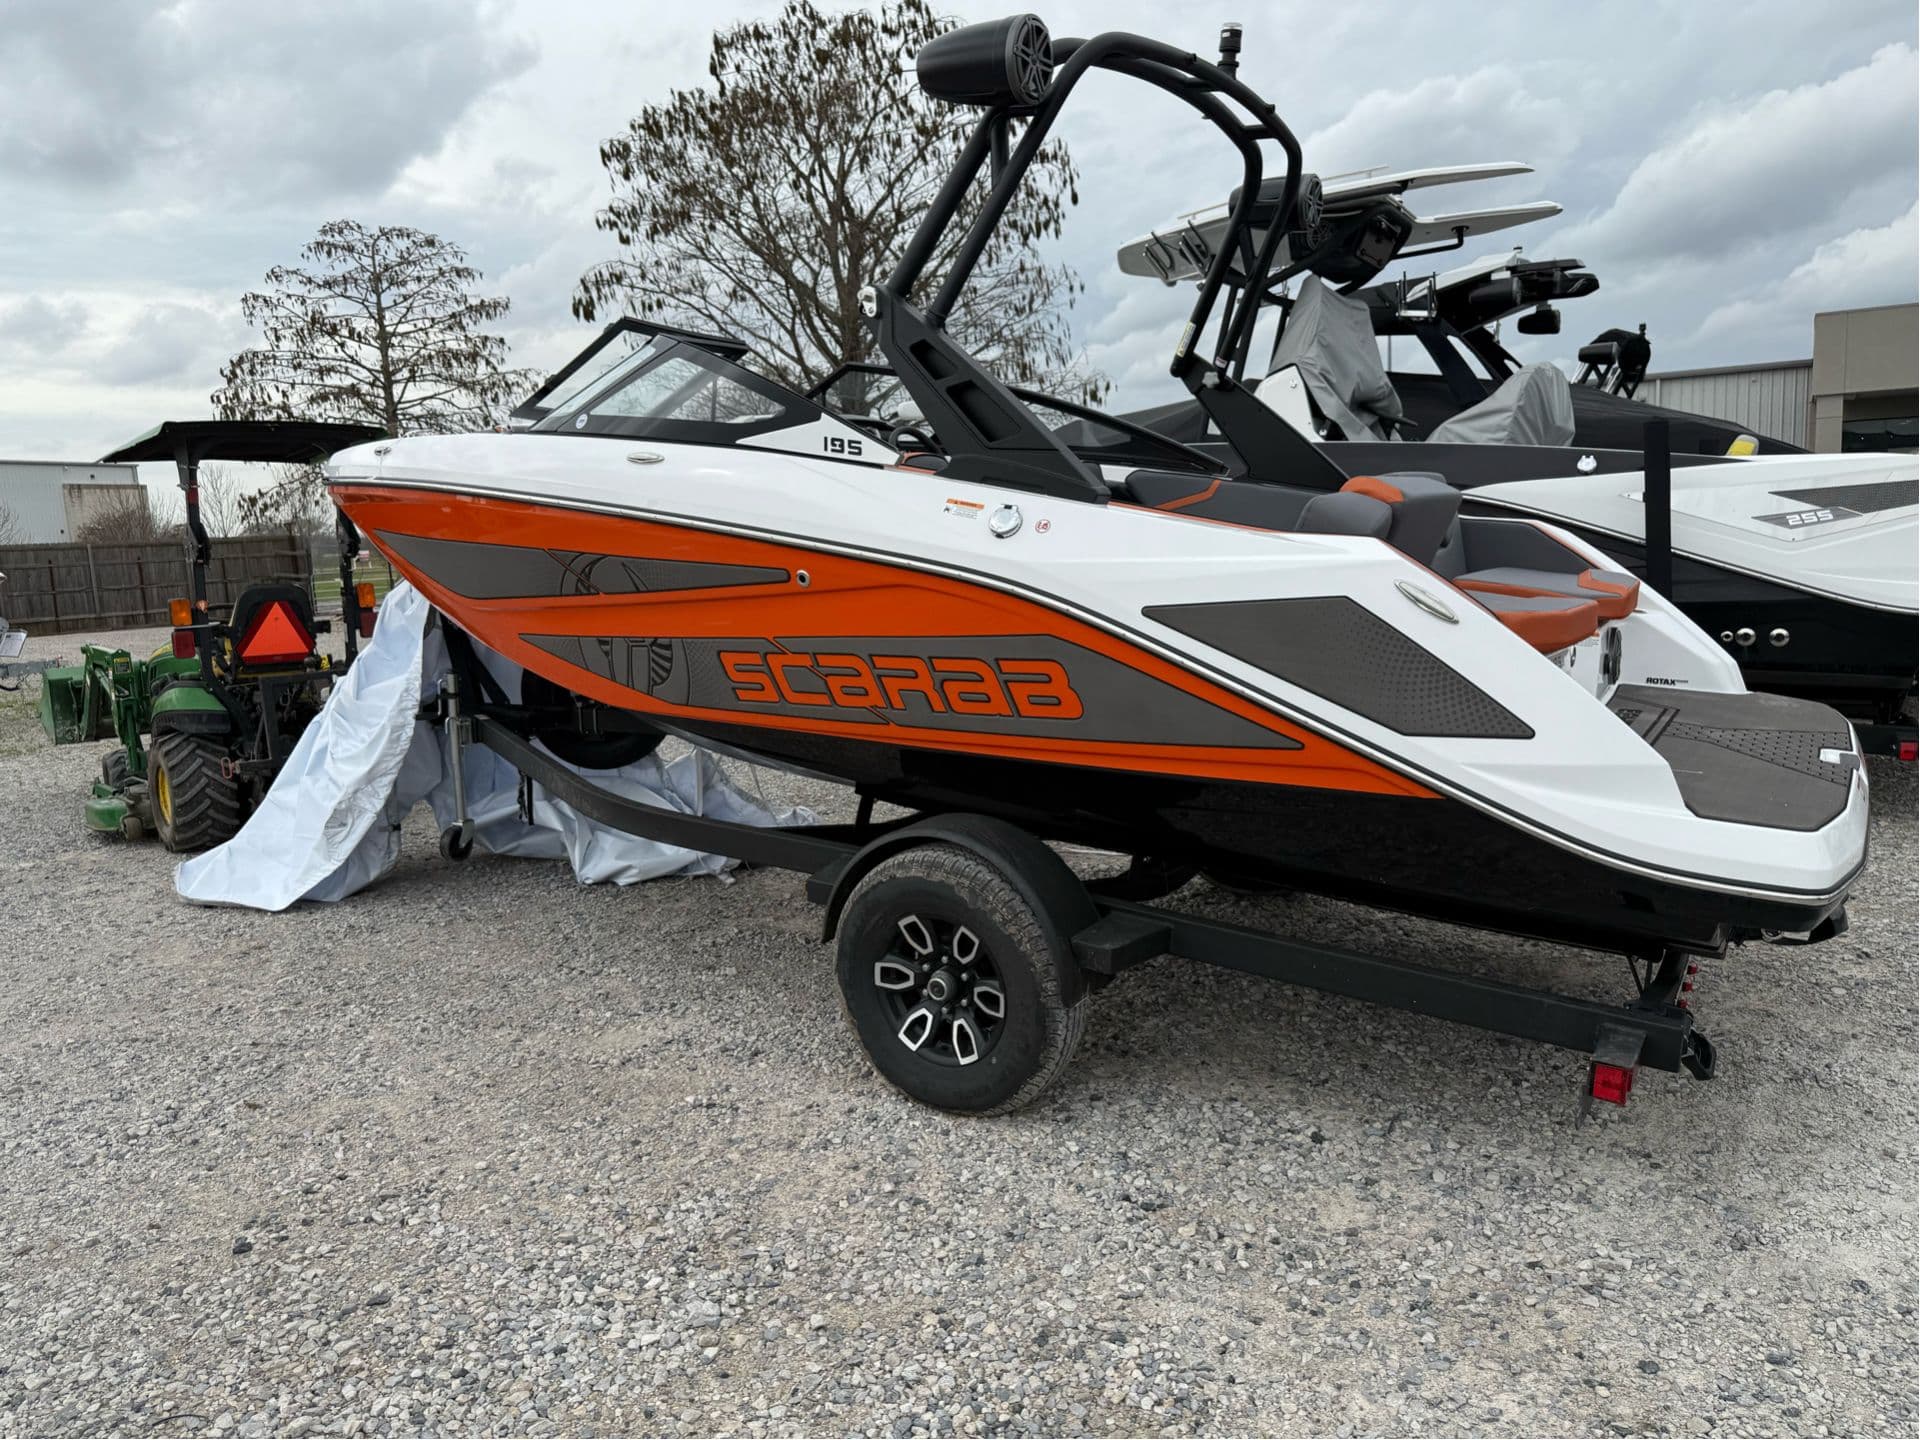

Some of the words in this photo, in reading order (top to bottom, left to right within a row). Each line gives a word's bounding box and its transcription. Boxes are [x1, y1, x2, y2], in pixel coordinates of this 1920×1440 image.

[824, 436, 862, 456] 195
[1786, 510, 1834, 526] 255
[719, 650, 1084, 720] SCARAB
[1646, 677, 1676, 685] ROTAX
